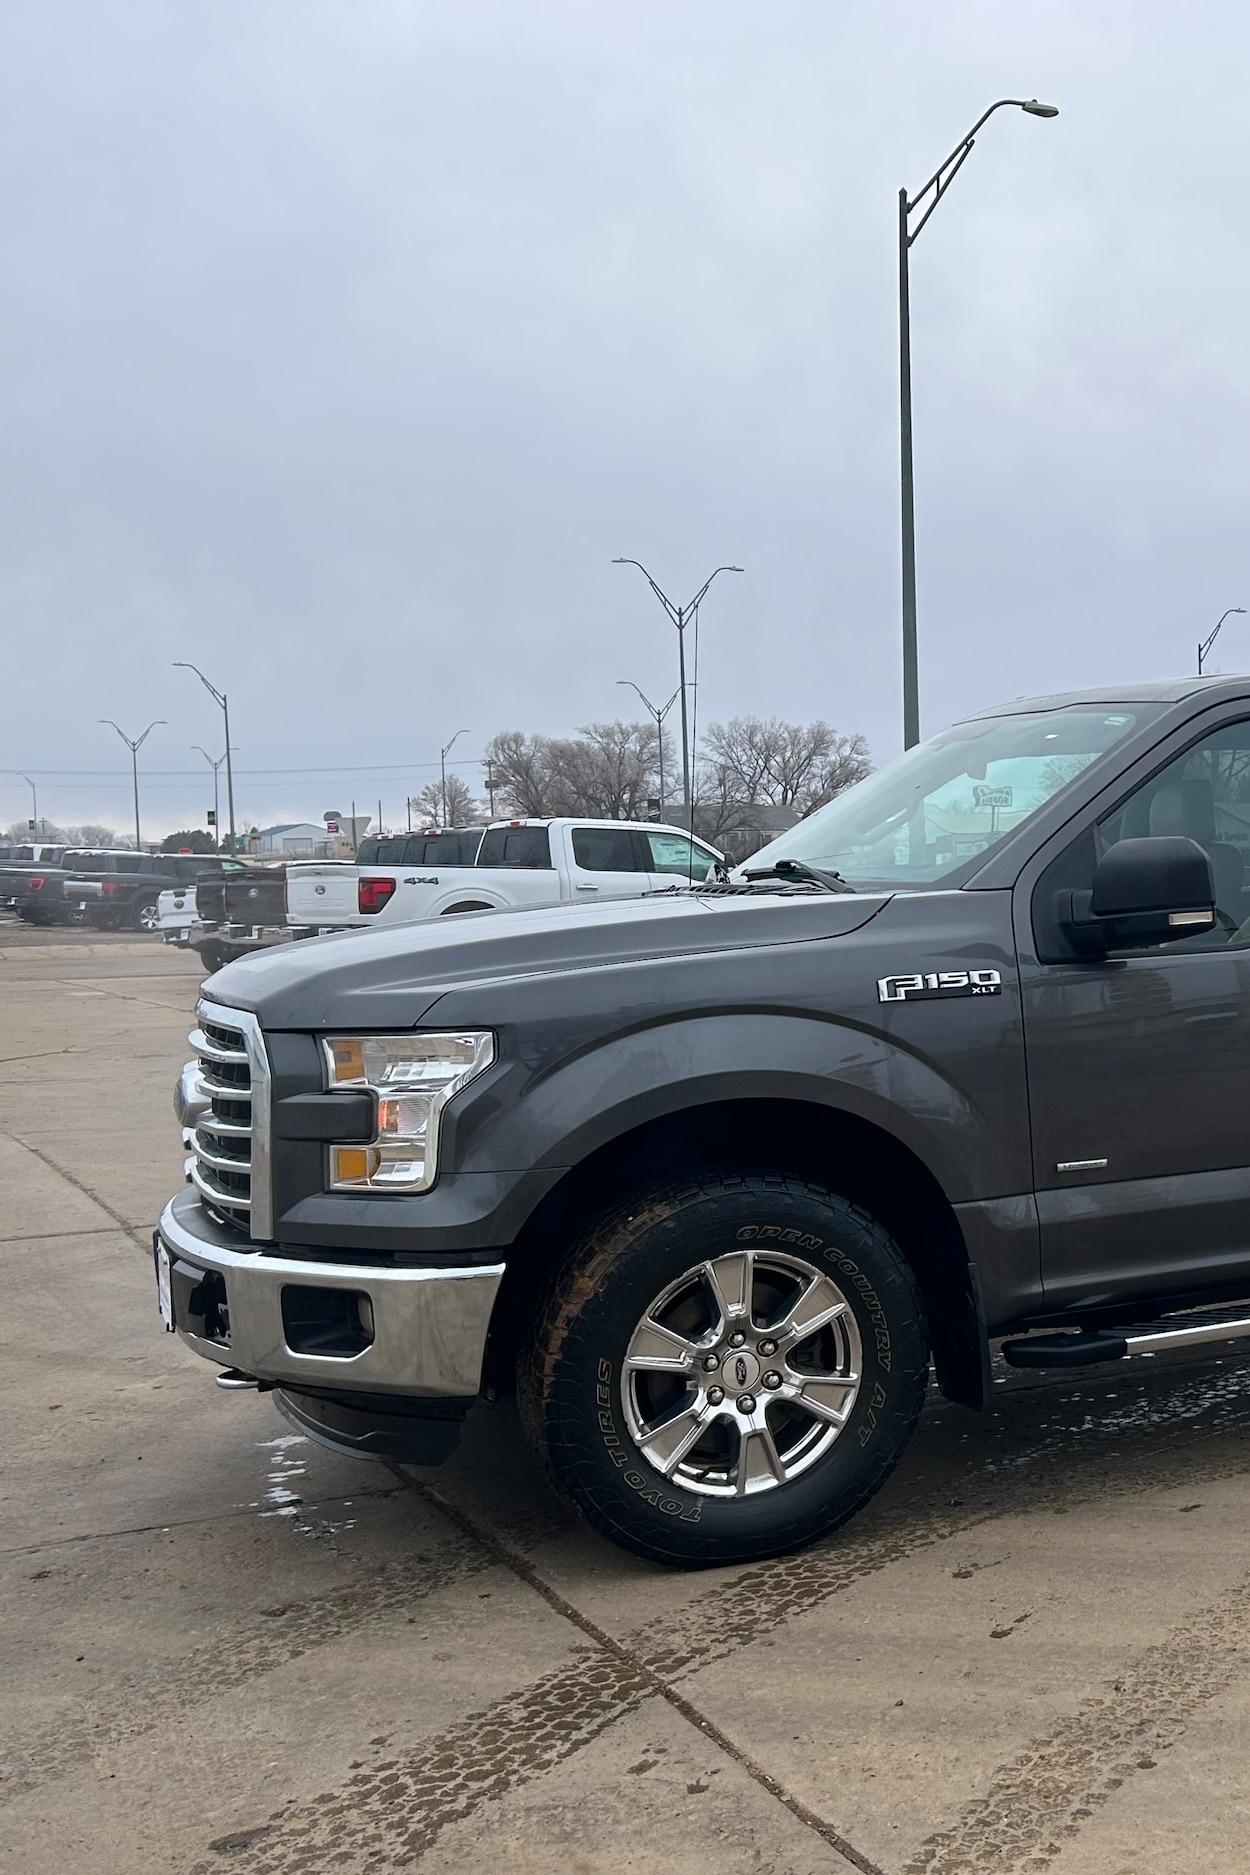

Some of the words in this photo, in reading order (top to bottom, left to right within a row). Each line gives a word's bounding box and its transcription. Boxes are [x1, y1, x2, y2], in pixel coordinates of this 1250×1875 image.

[971, 985, 997, 994] XLT
[736, 1225, 824, 1250] OPEN
[822, 1247, 893, 1372] COUNTRY
[596, 1358, 629, 1468] TIRES
[857, 1381, 887, 1448] A/T
[623, 1470, 702, 1523] TOYO
